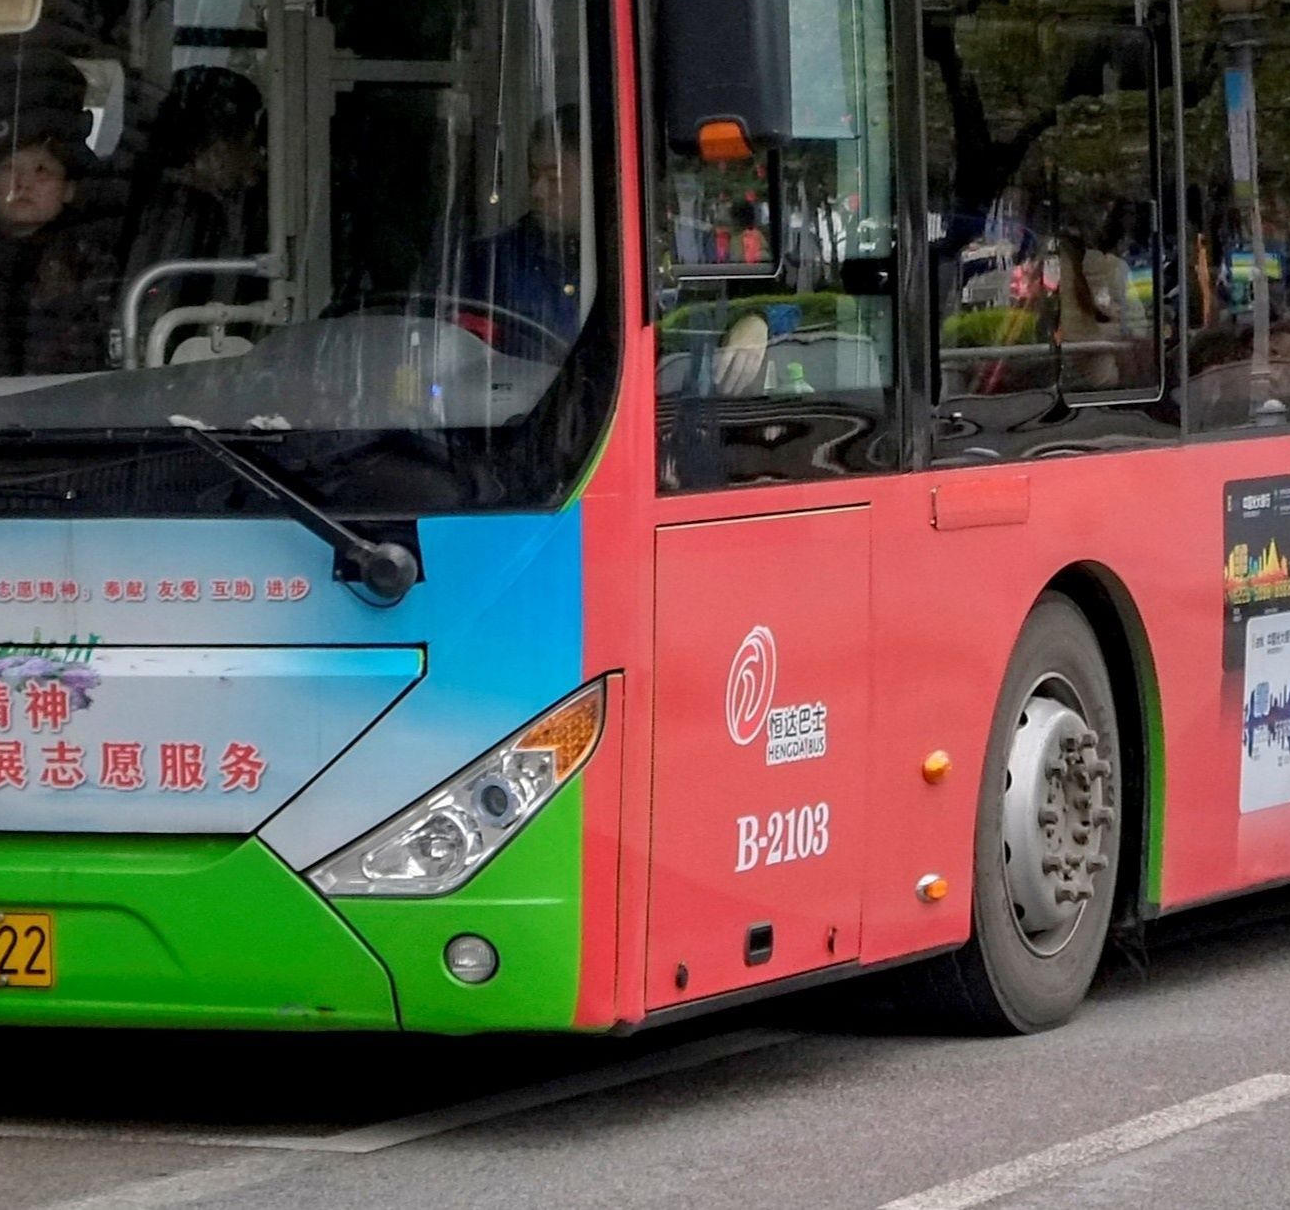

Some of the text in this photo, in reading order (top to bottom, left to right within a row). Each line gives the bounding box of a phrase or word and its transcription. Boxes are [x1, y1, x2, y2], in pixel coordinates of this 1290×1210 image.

[104, 580, 147, 602] 奉献
[157, 580, 200, 602] 友爱
[212, 580, 254, 602] 互助
[265, 580, 309, 602] 进步
[770, 708, 825, 739] 恒达巴士
[808, 736, 825, 755] BUS
[734, 802, 830, 872] B-2103
